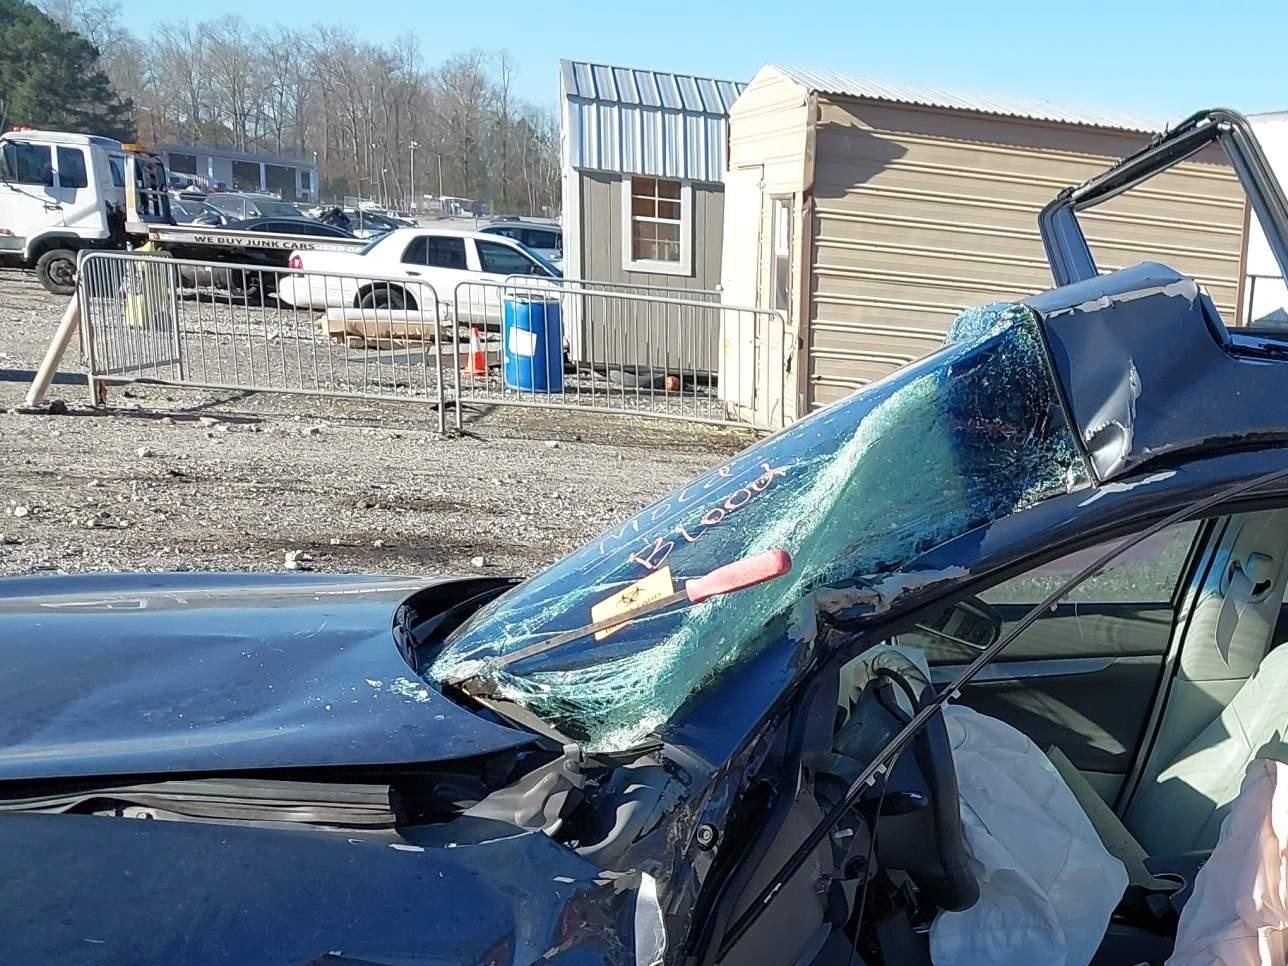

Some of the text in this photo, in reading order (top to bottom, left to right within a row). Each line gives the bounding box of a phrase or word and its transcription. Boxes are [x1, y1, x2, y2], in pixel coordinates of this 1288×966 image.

[194, 235, 214, 243] WE
[217, 237, 243, 245] BUY
[245, 239, 280, 248] JUNK
[282, 241, 315, 250] CARS
